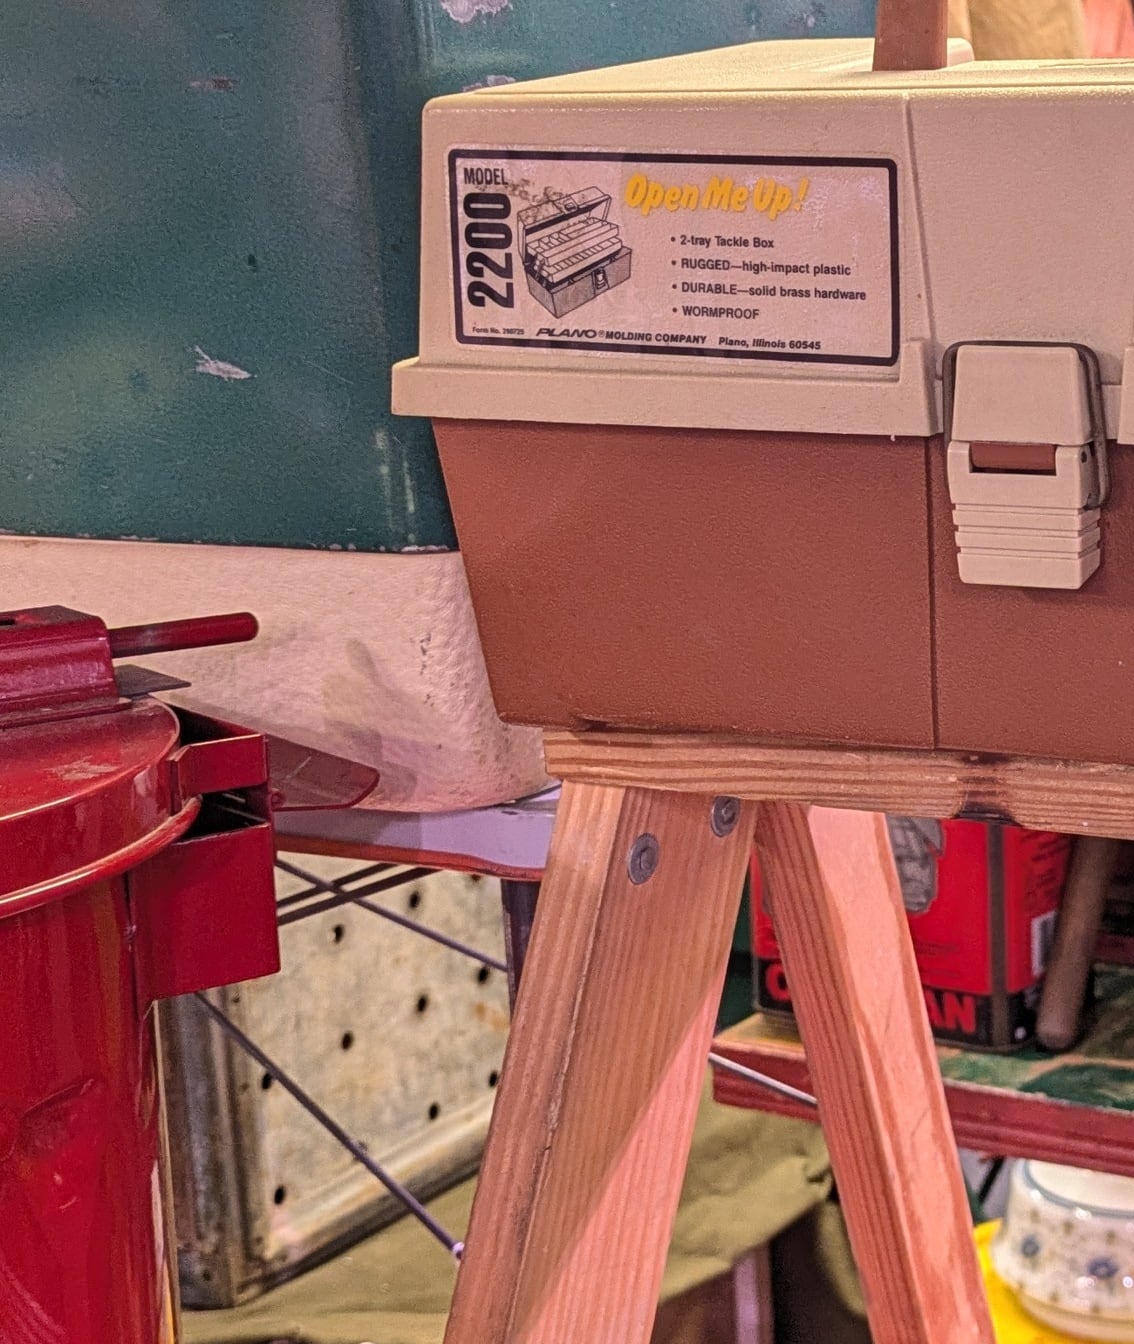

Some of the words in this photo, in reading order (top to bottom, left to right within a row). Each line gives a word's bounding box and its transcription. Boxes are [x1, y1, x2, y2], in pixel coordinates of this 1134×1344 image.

[464, 167, 509, 186] MODEL
[624, 172, 700, 217] Open
[702, 175, 749, 213] Me
[753, 176, 810, 221] Up!
[679, 234, 711, 248] 2-tray
[714, 235, 750, 248] Tackle
[753, 237, 774, 248] Box
[463, 192, 515, 309] 2200
[813, 263, 852, 277] plastic
[780, 286, 811, 298] brass
[814, 287, 866, 301] hardware
[682, 306, 760, 320] WORMPROOF
[535, 327, 597, 339] PLANO
[605, 330, 651, 342] MOLDING
[655, 333, 706, 344] COMPANY
[719, 337, 749, 348] Plano,
[752, 338, 786, 349] Illinois
[789, 340, 821, 351] 60545
